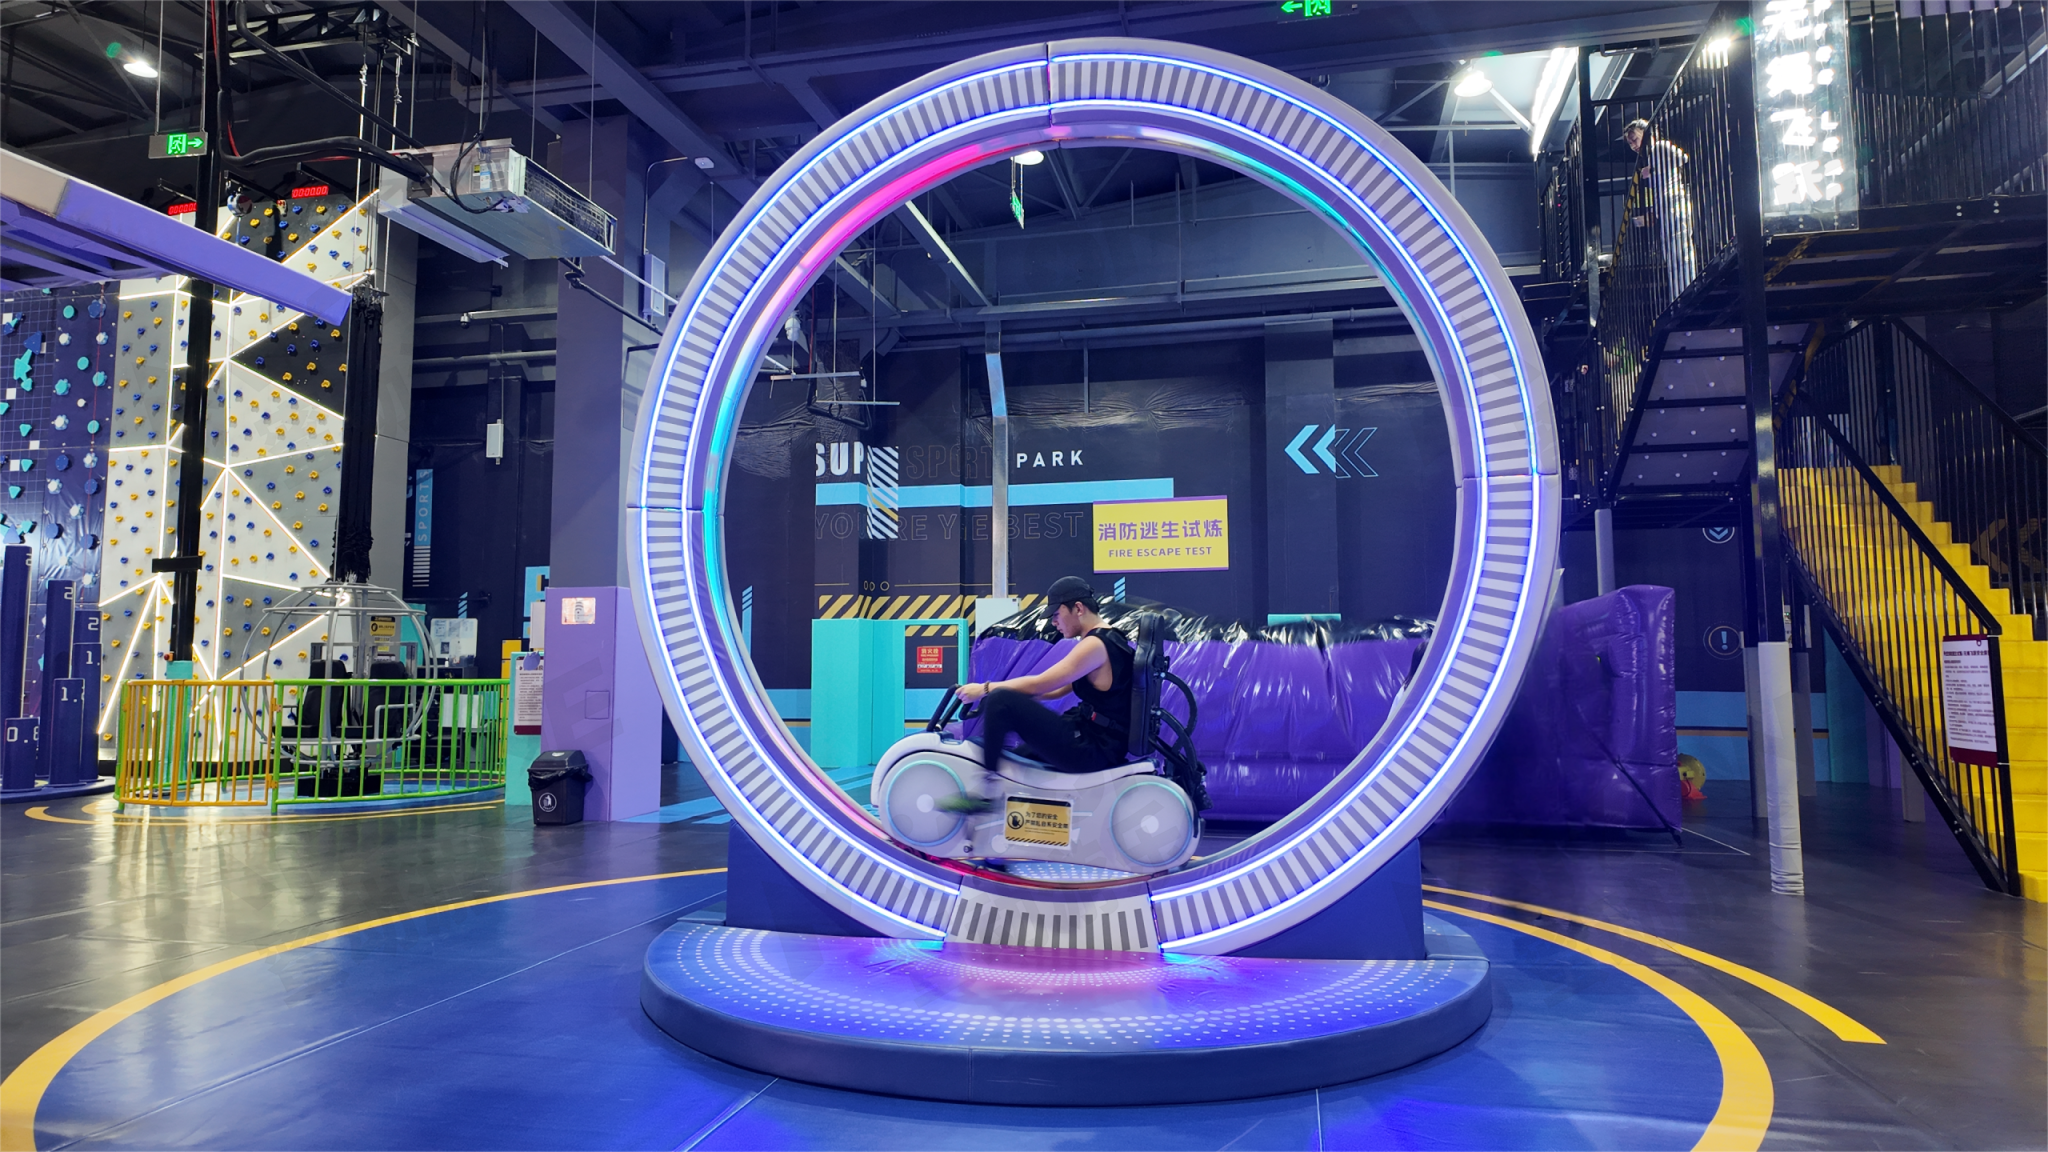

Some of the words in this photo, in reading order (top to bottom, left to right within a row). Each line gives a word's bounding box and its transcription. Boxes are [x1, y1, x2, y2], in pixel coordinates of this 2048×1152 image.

[1016, 449, 1084, 469] PARK
[417, 471, 430, 542] SPORTS
[1098, 518, 1223, 541] 消防逃生试炼
[1108, 549, 1133, 558] FIRE
[1137, 547, 1181, 557] ESCAPE
[1185, 546, 1212, 556] TEST
